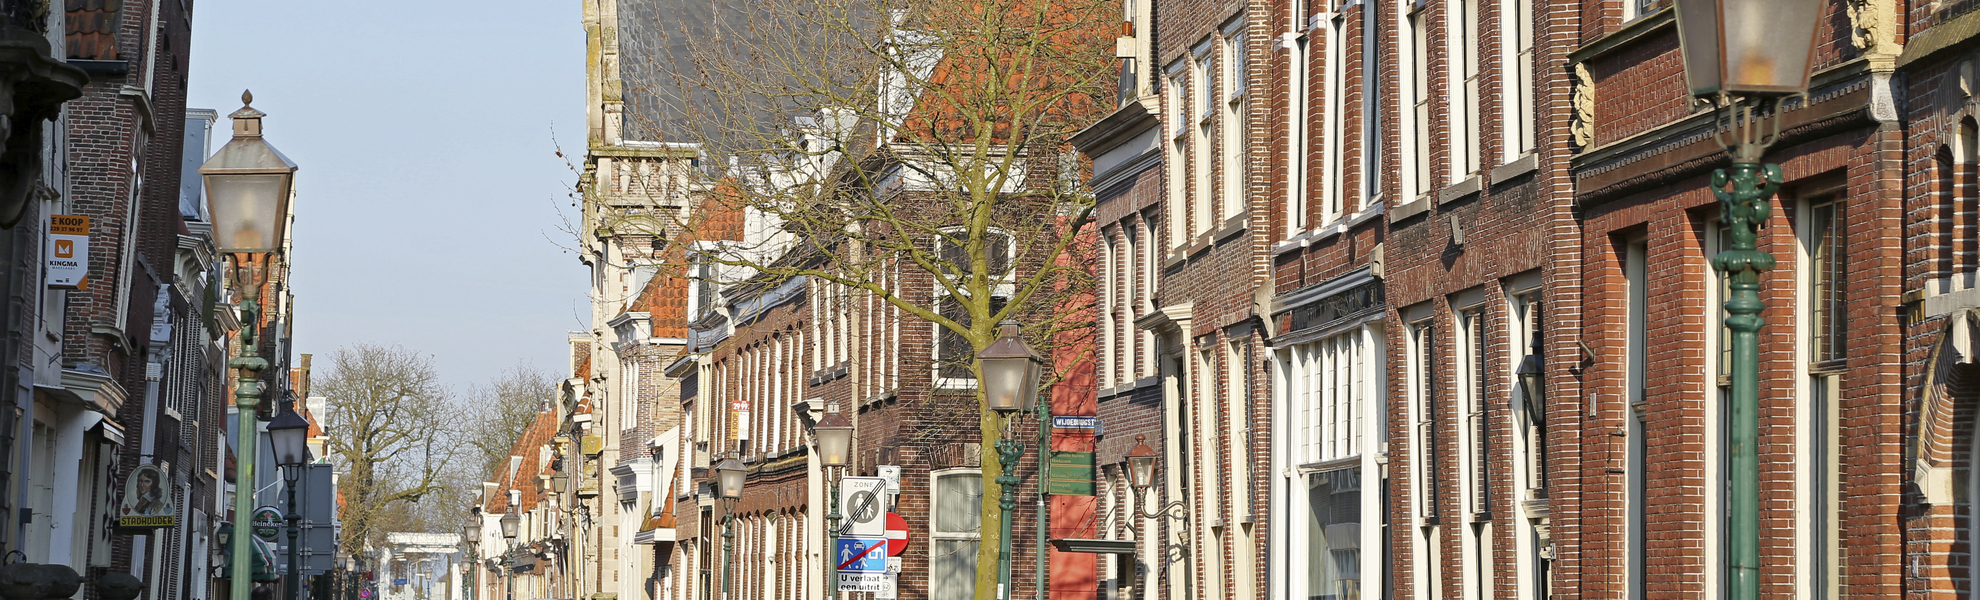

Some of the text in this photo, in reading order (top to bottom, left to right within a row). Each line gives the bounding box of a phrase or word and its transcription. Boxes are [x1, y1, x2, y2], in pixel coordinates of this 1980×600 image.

[59, 217, 84, 226] KOOP
[121, 516, 173, 525] STADHOUDER
[841, 574, 848, 582] U
